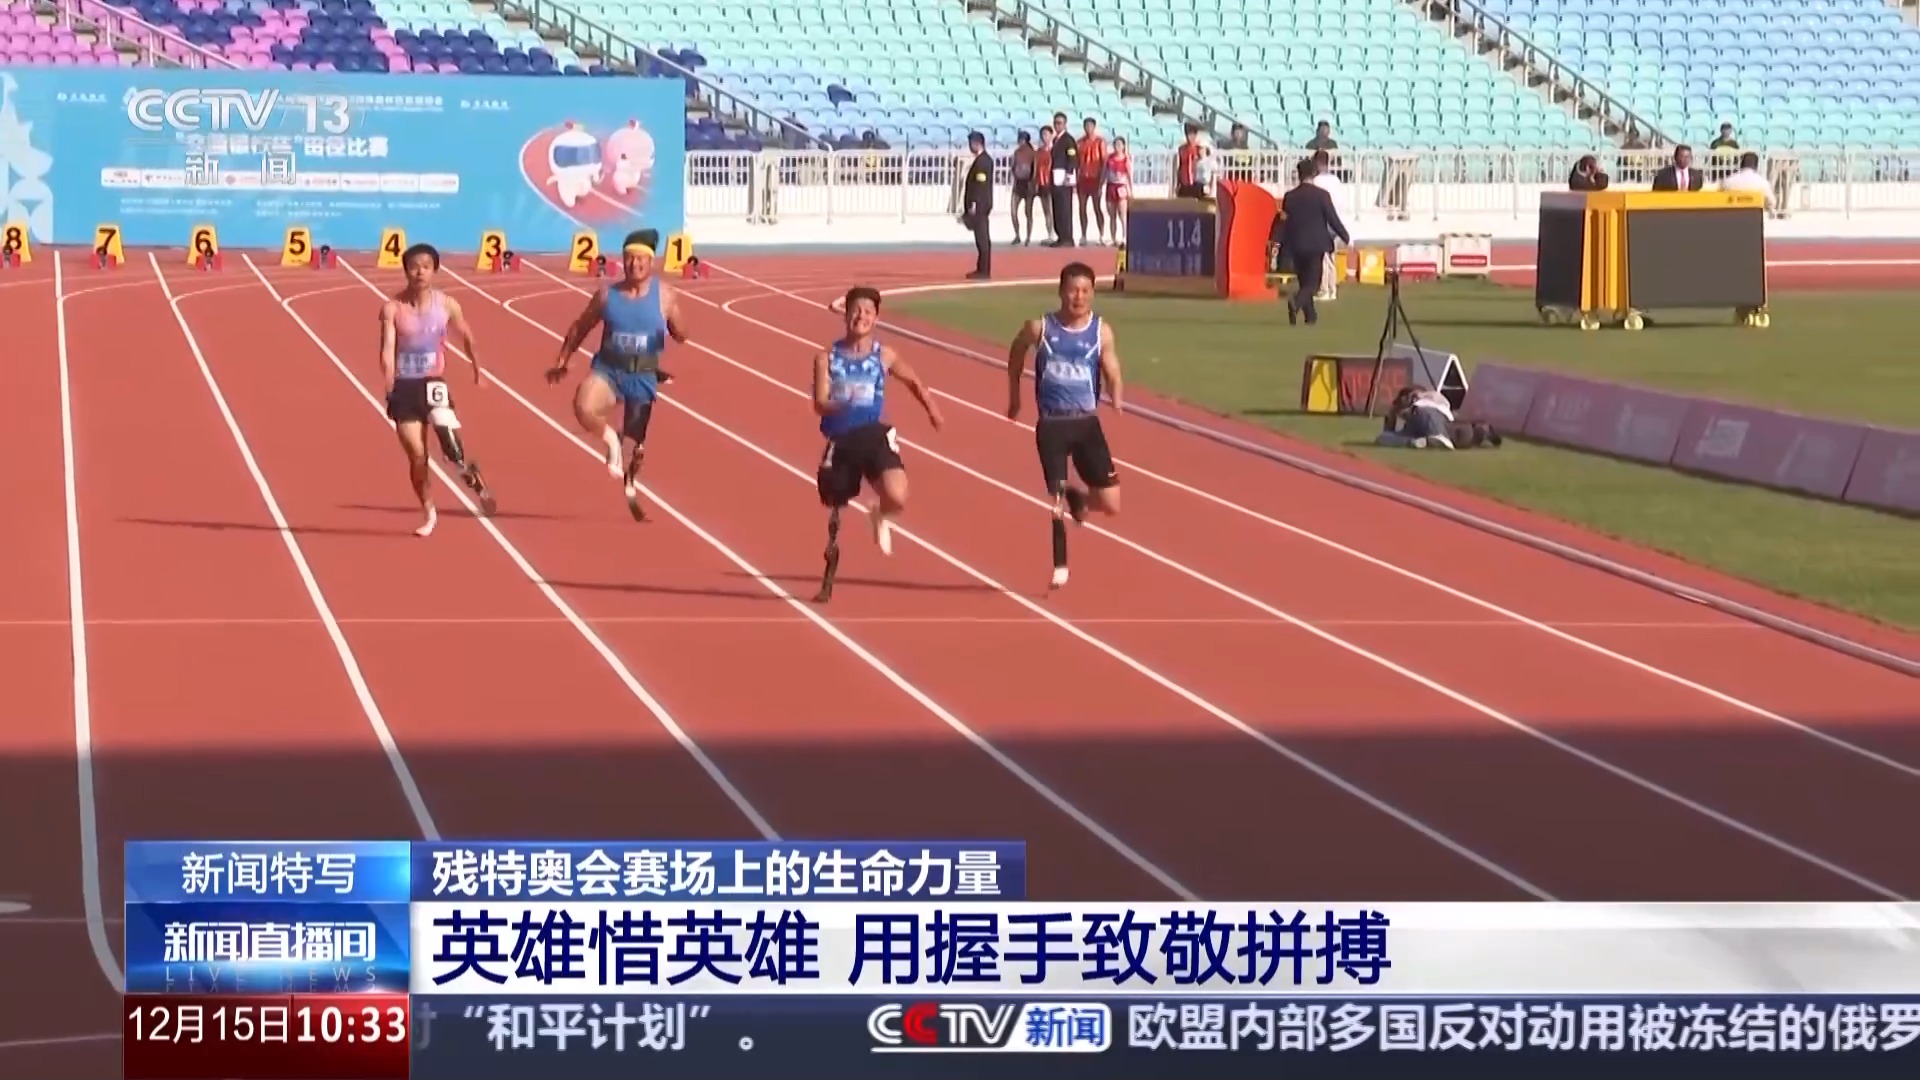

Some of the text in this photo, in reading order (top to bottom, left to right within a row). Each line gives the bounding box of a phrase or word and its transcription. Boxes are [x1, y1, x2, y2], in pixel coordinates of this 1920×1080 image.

[6, 226, 22, 250] 8
[98, 227, 117, 252] 7
[195, 229, 212, 256] 6
[289, 231, 305, 255] 5
[384, 233, 401, 257] 4
[485, 234, 501, 258] 3
[577, 236, 593, 261] 2
[672, 238, 682, 262] 1
[432, 385, 444, 402] 6
